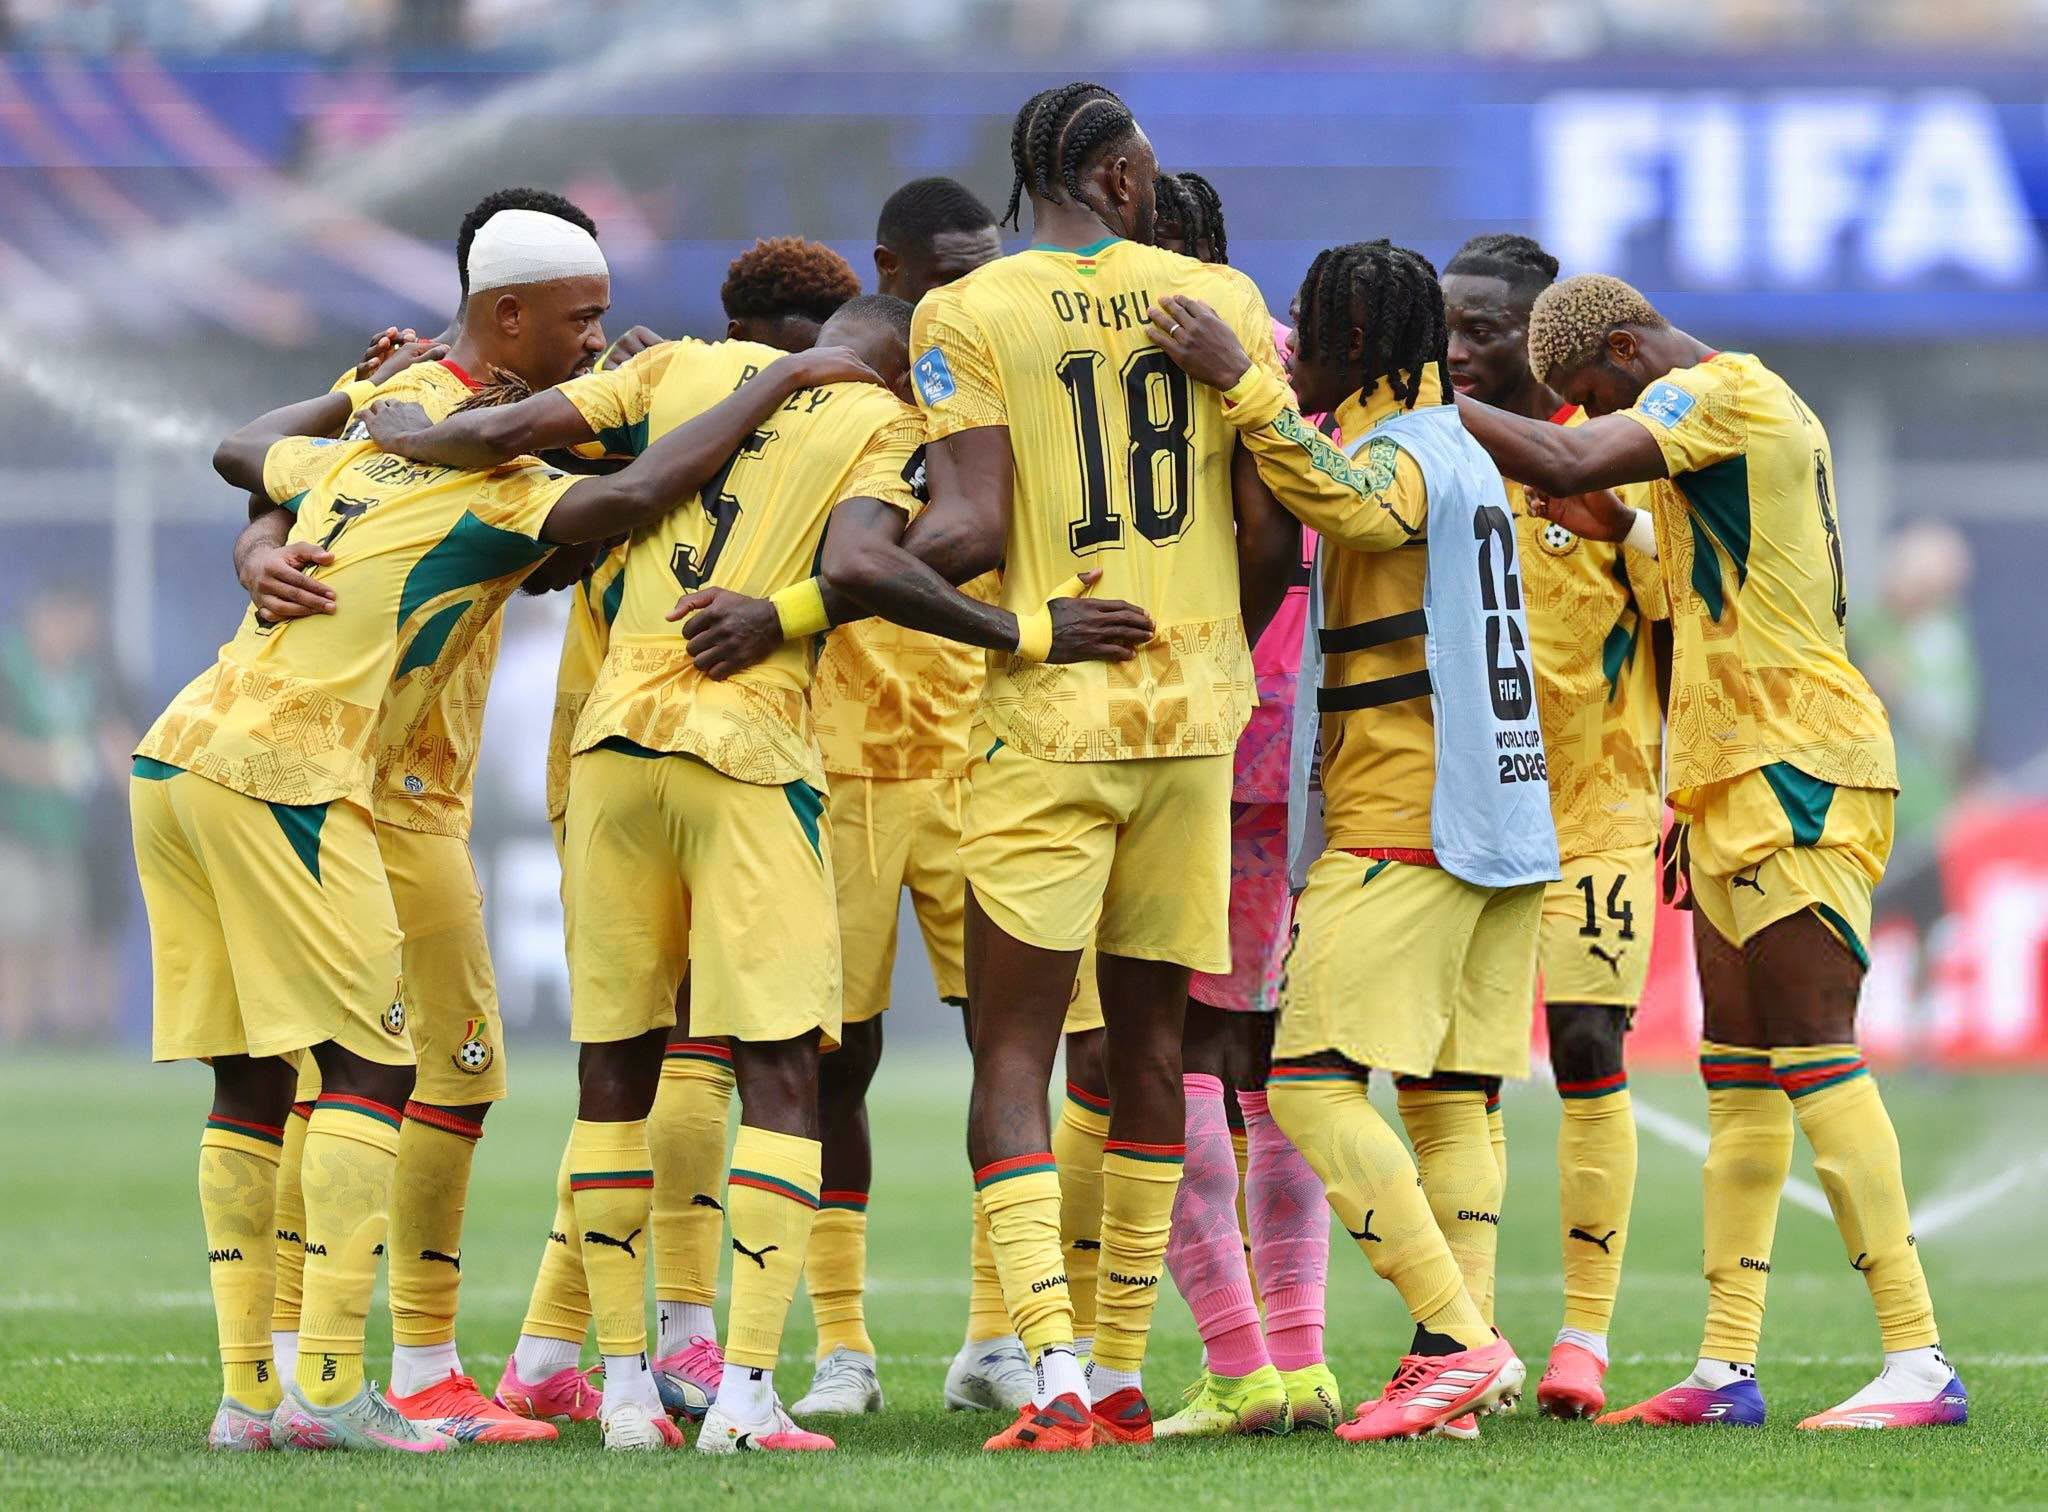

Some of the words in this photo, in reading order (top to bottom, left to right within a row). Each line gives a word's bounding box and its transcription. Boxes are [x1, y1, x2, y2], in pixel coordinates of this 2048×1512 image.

[1543, 93, 2037, 280] FIFA
[733, 364, 832, 413] PEY
[1056, 346, 1195, 557] 18
[1498, 679, 1522, 701] FIFA
[1525, 731, 1540, 748] CUP
[1498, 753, 1547, 784] 2026
[1576, 874, 1634, 941] 14
[1457, 1210, 1500, 1226] GHAN
[1110, 1272, 1158, 1287] GHANA
